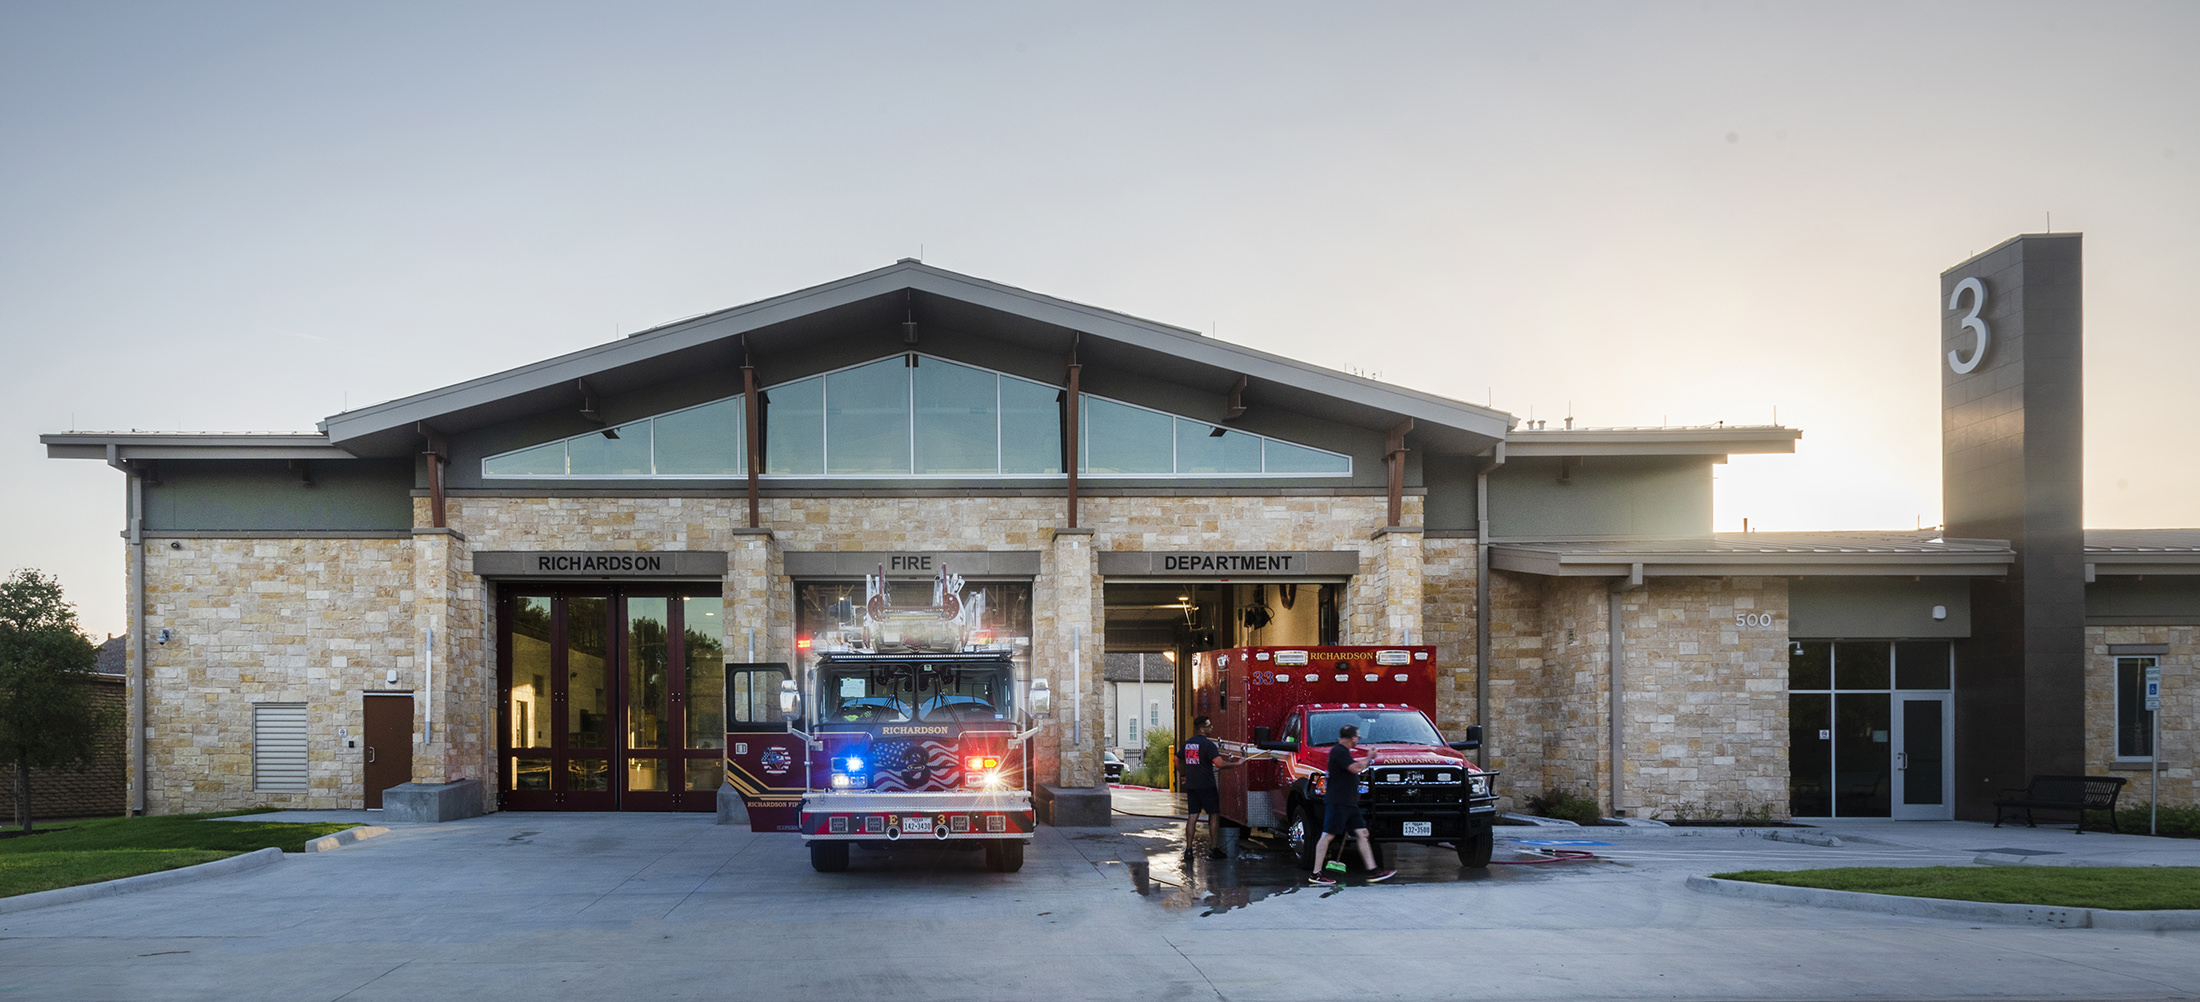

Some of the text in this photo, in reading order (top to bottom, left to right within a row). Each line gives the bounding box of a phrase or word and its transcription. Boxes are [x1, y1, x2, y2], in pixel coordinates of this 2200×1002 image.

[1948, 277, 1991, 374] 3
[538, 556, 1292, 570] RICHARDSON FIRE DEPARTMENT
[1735, 613, 1772, 627] 500
[1310, 652, 1373, 660] RICHARDSON
[1253, 671, 1274, 685] 33
[882, 726, 948, 735] RICHARDSON
[901, 746, 931, 787] 3
[888, 814, 946, 826] E 3
